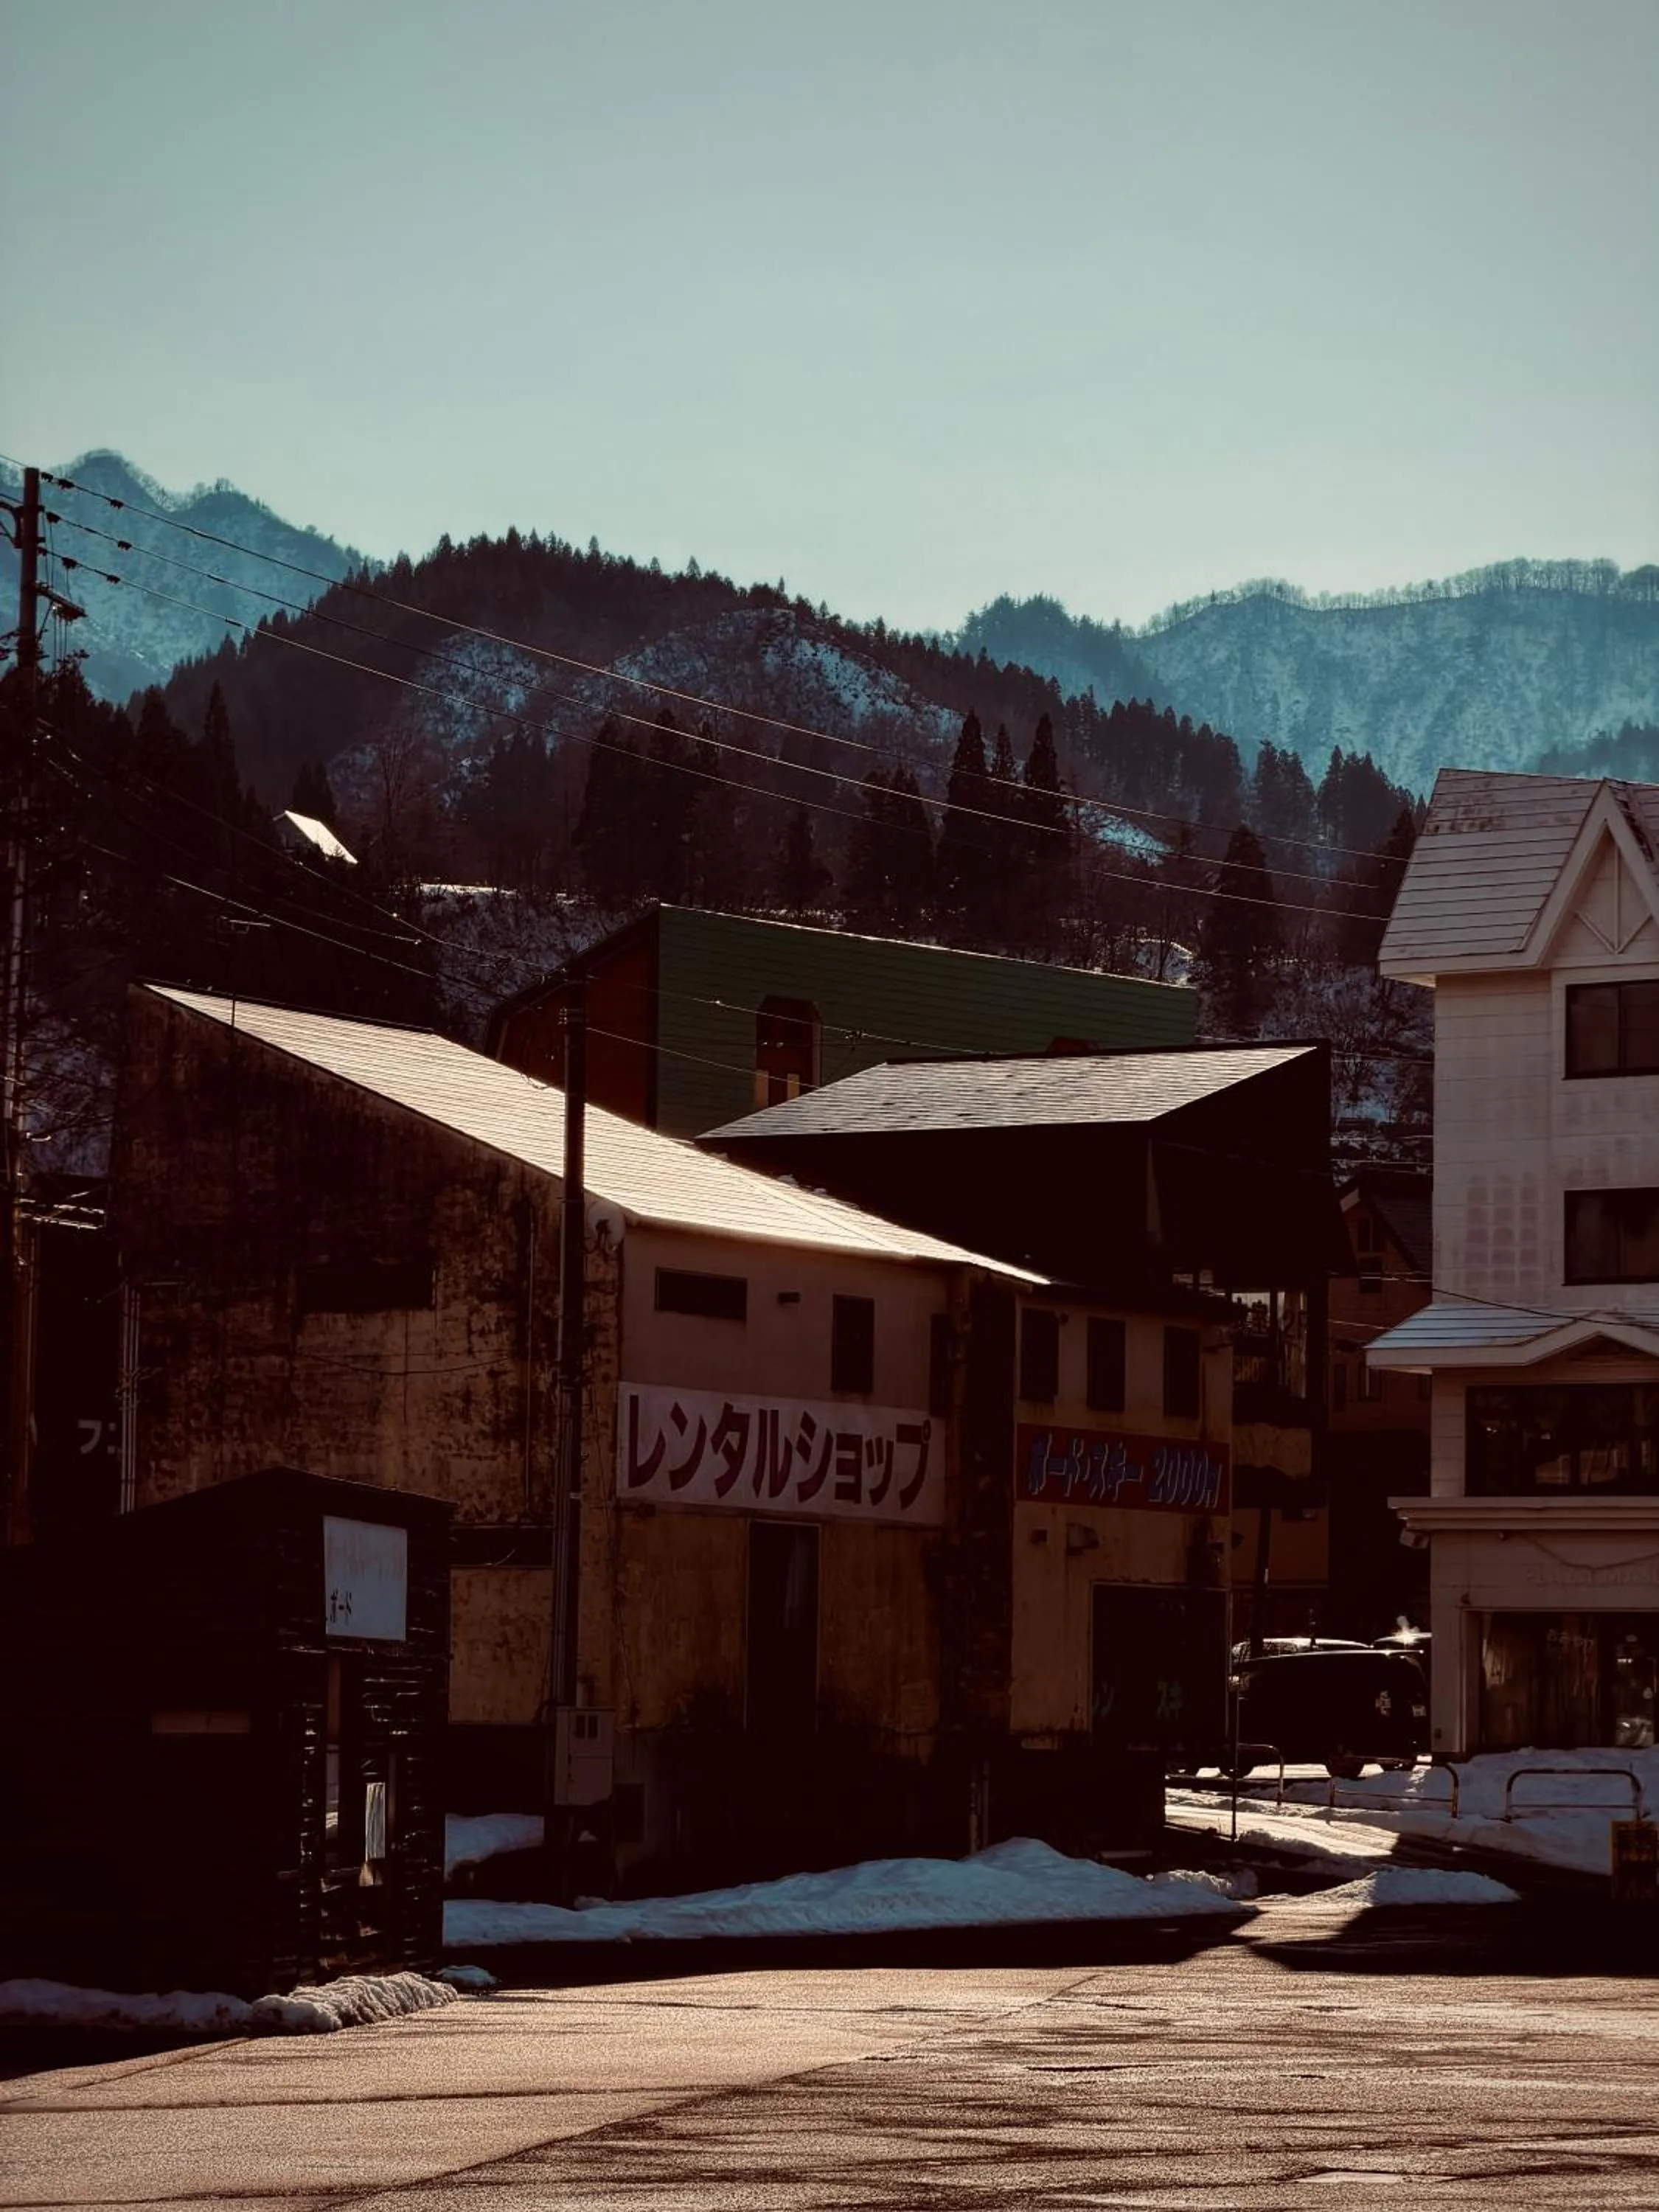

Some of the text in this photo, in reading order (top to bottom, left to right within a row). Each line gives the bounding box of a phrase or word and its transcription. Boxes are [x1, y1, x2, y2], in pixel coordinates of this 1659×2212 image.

[628, 1394, 931, 1510] レンタルショップ
[1147, 1445, 1225, 1510] 2000円
